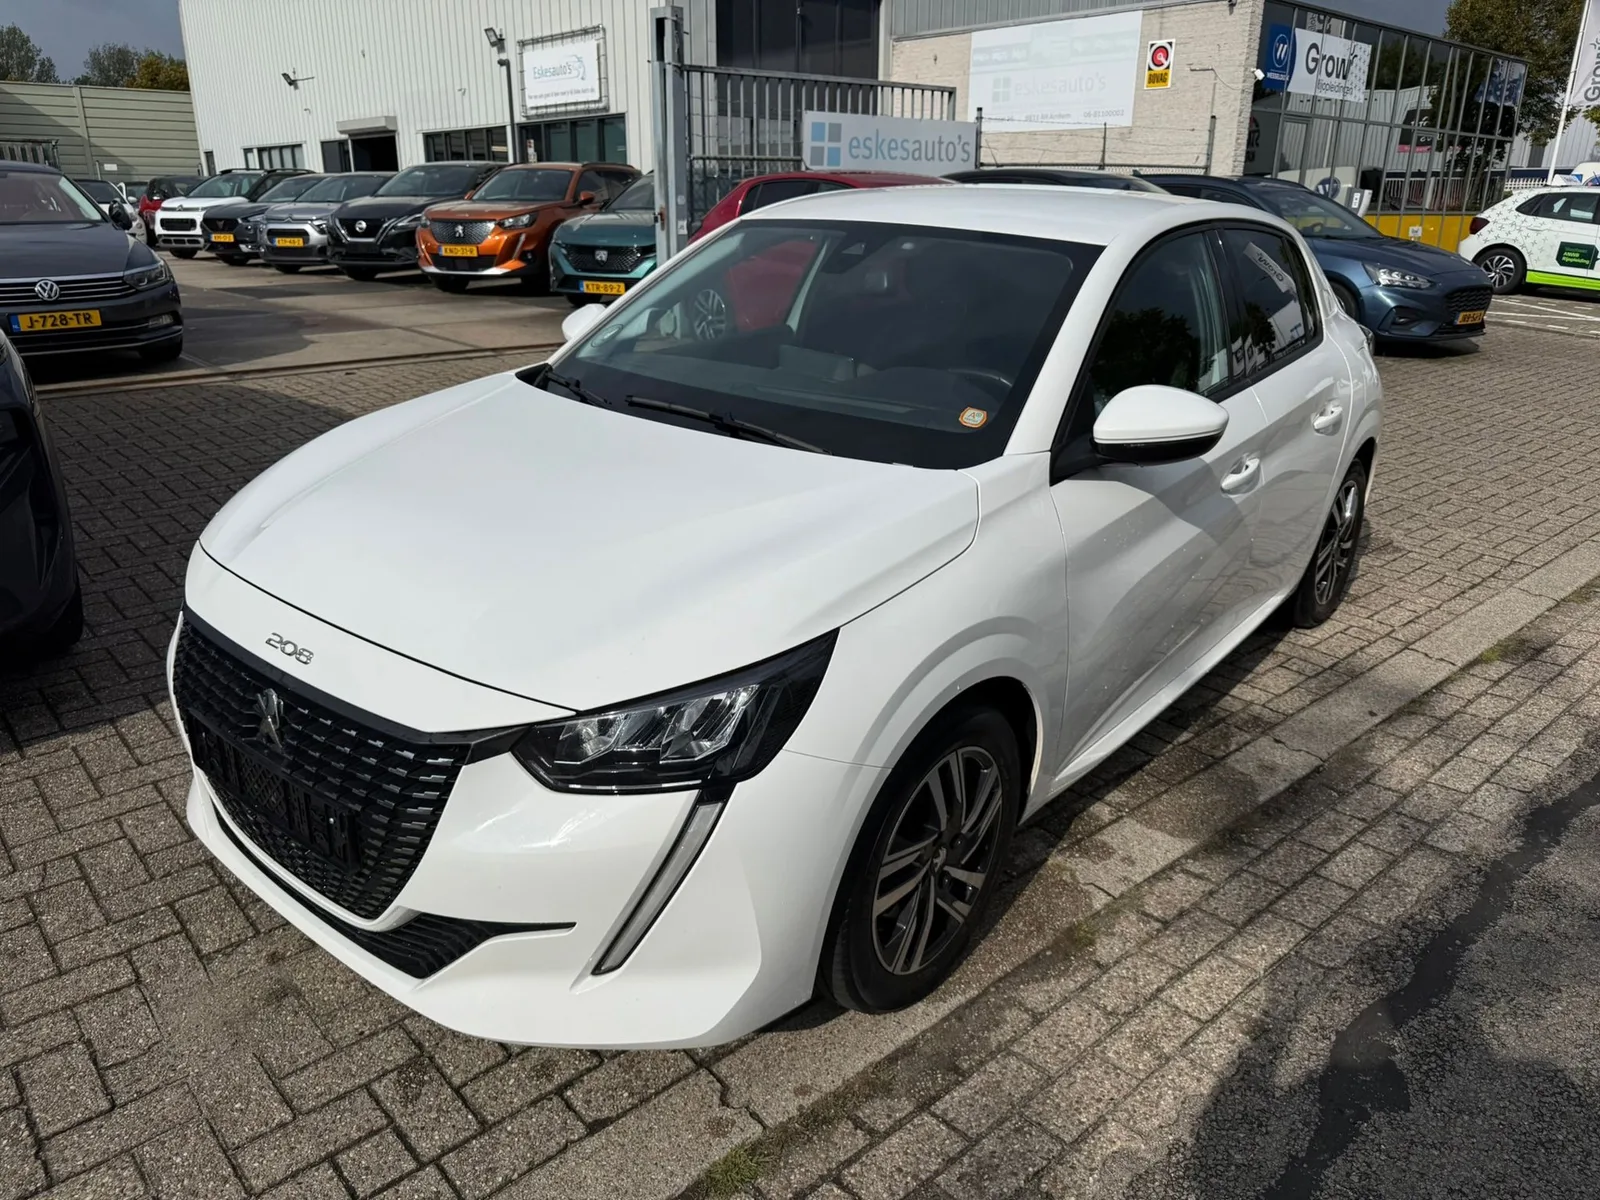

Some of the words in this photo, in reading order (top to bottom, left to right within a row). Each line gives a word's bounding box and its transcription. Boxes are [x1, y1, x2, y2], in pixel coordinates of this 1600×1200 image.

[533, 62, 573, 79] Eskesauto's
[1305, 42, 1353, 81] Grow
[1014, 71, 1106, 97] eskesauto's
[1148, 72, 1169, 84] BOVAG
[849, 128, 971, 163] eskesauto's
[27, 312, 94, 329] J-728-TR
[265, 632, 314, 665] 208
